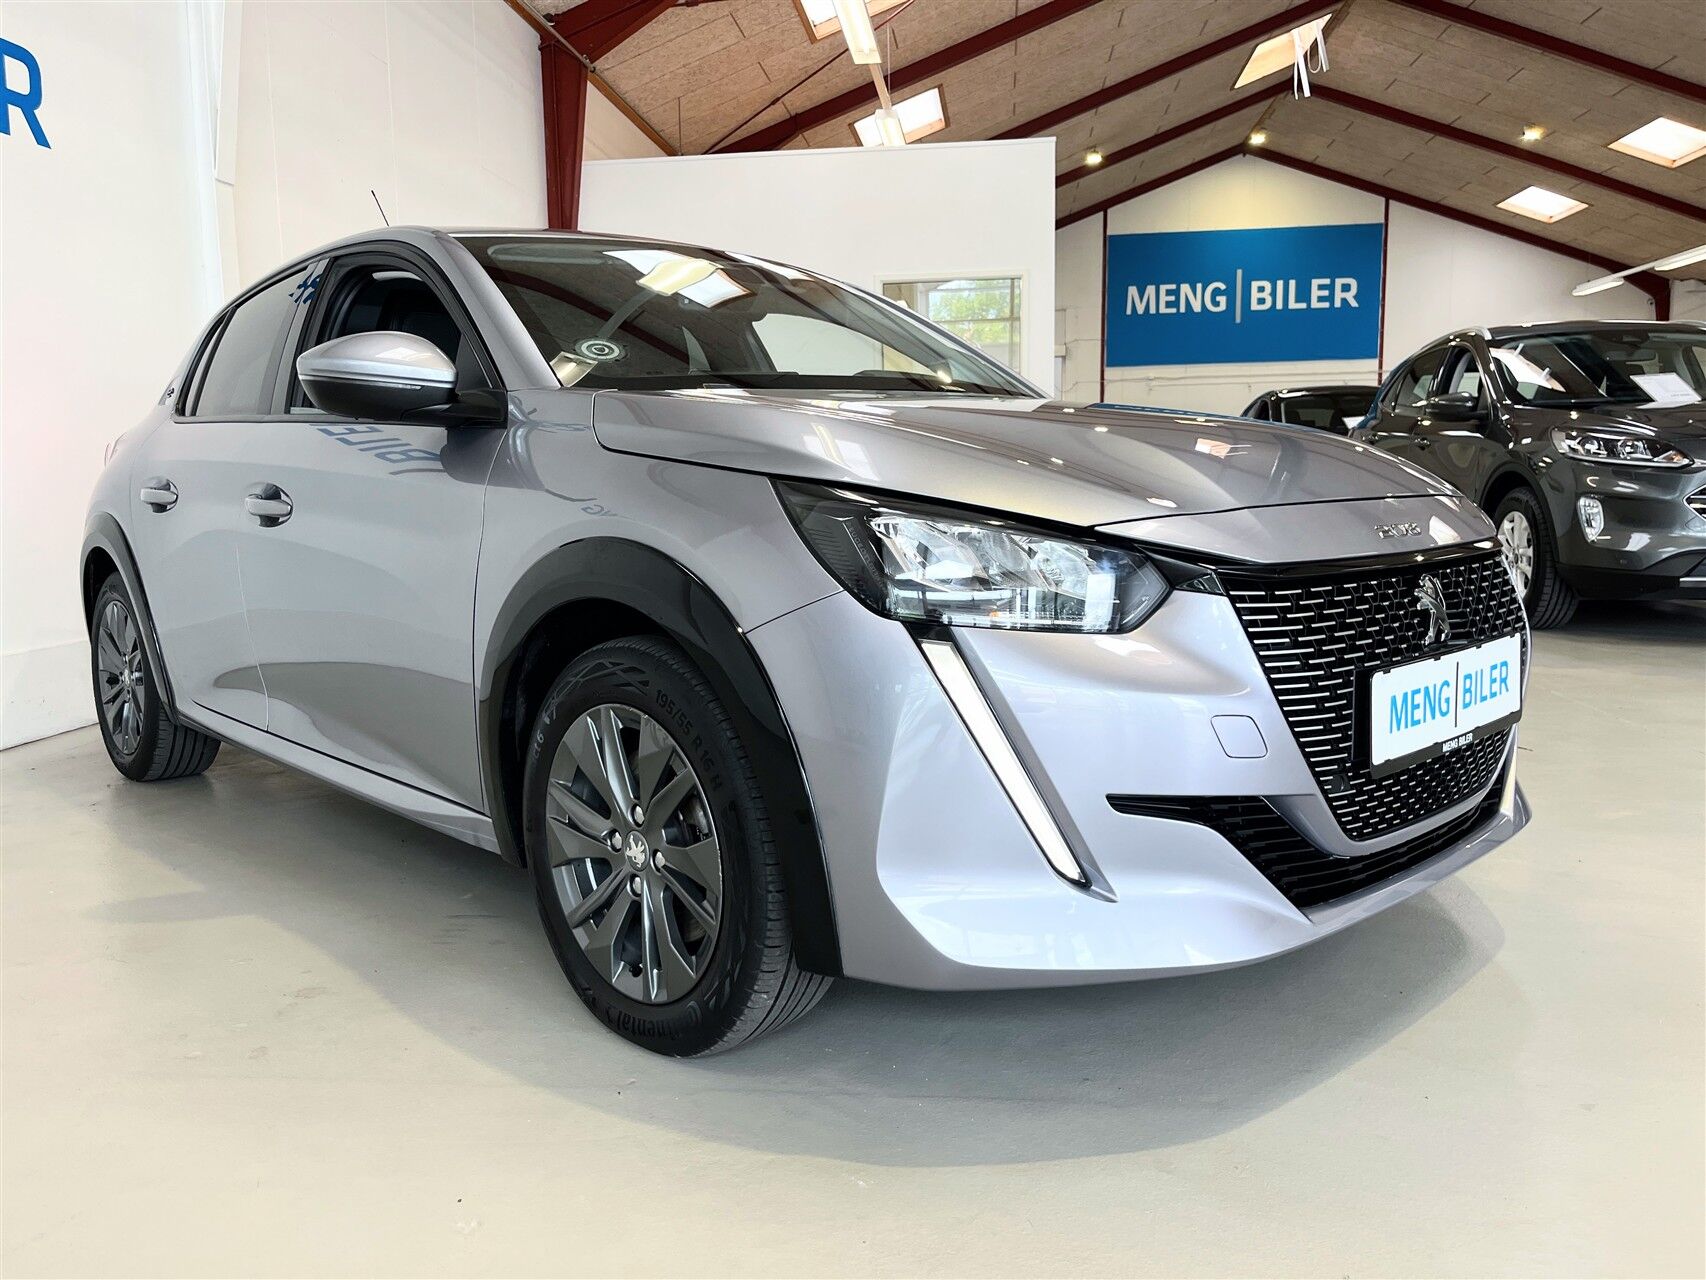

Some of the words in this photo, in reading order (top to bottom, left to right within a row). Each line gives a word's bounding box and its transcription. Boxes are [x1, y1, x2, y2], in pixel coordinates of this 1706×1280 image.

[1125, 281, 1228, 316] MENG
[1249, 277, 1360, 311] BILER
[656, 689, 694, 735] 195/55
[1389, 680, 1450, 734] MENG
[1462, 660, 1510, 710] BILER
[1442, 738, 1458, 753] MENG
[1459, 732, 1473, 747] BILER
